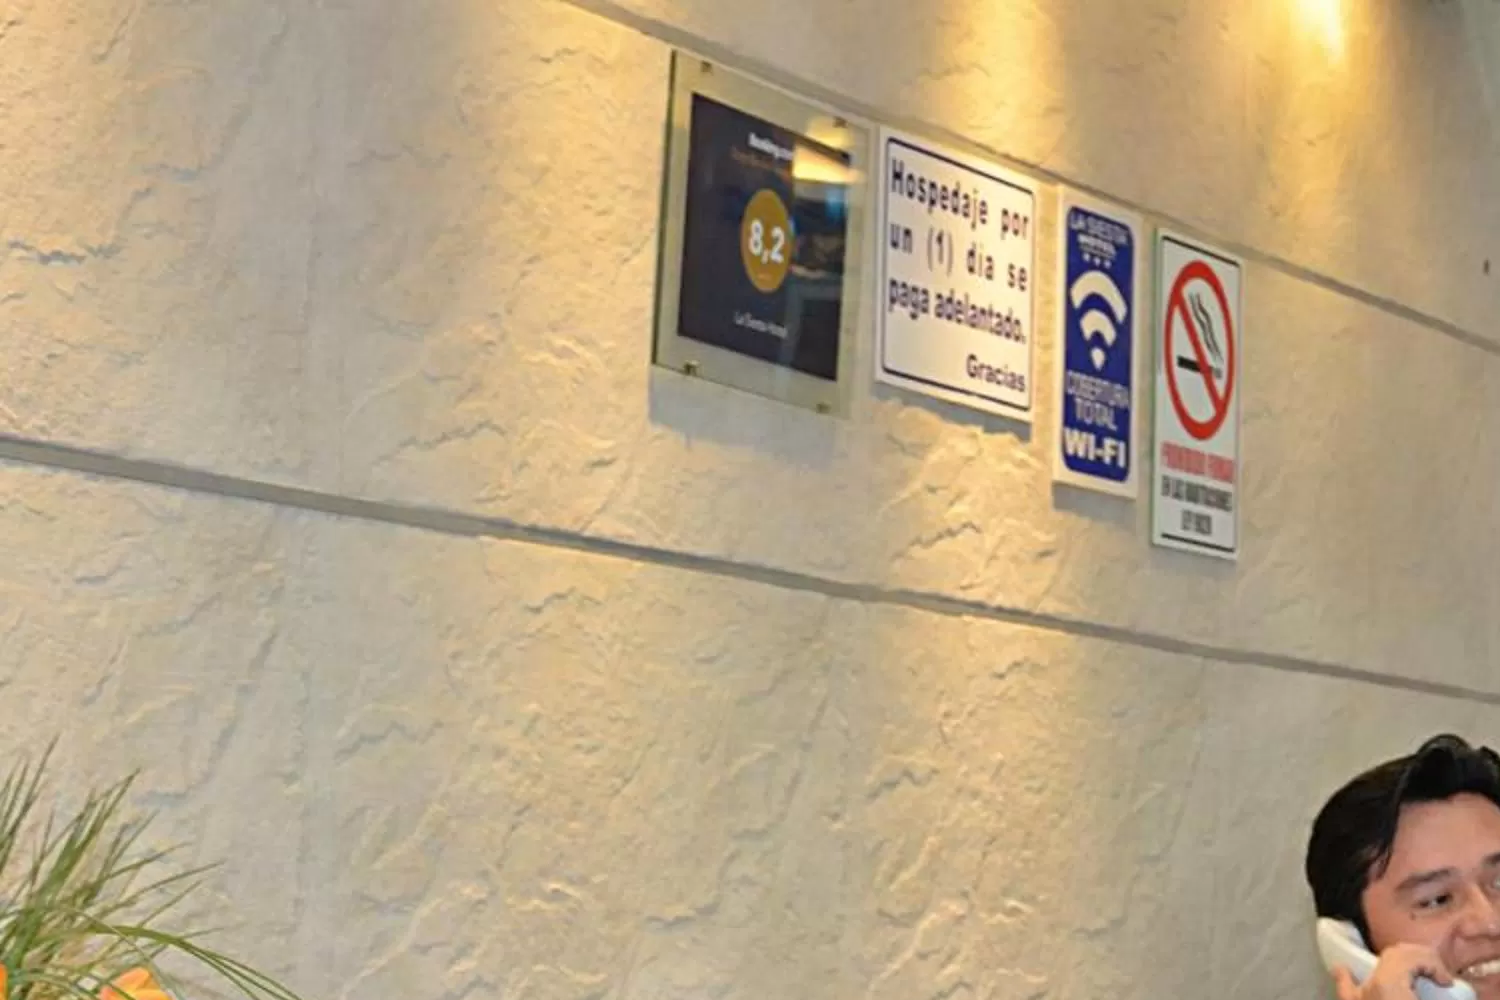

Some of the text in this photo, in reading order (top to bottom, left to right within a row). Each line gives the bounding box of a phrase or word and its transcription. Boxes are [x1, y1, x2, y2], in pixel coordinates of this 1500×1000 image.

[891, 158, 1029, 240] Hospedaje por
[748, 217, 786, 266] 8,2
[890, 223, 913, 254] un
[927, 226, 954, 278] (1)
[1007, 262, 1028, 292] se
[889, 278, 930, 321] paga
[966, 353, 1026, 392] Gracias
[1064, 426, 1126, 468] WI-FI
